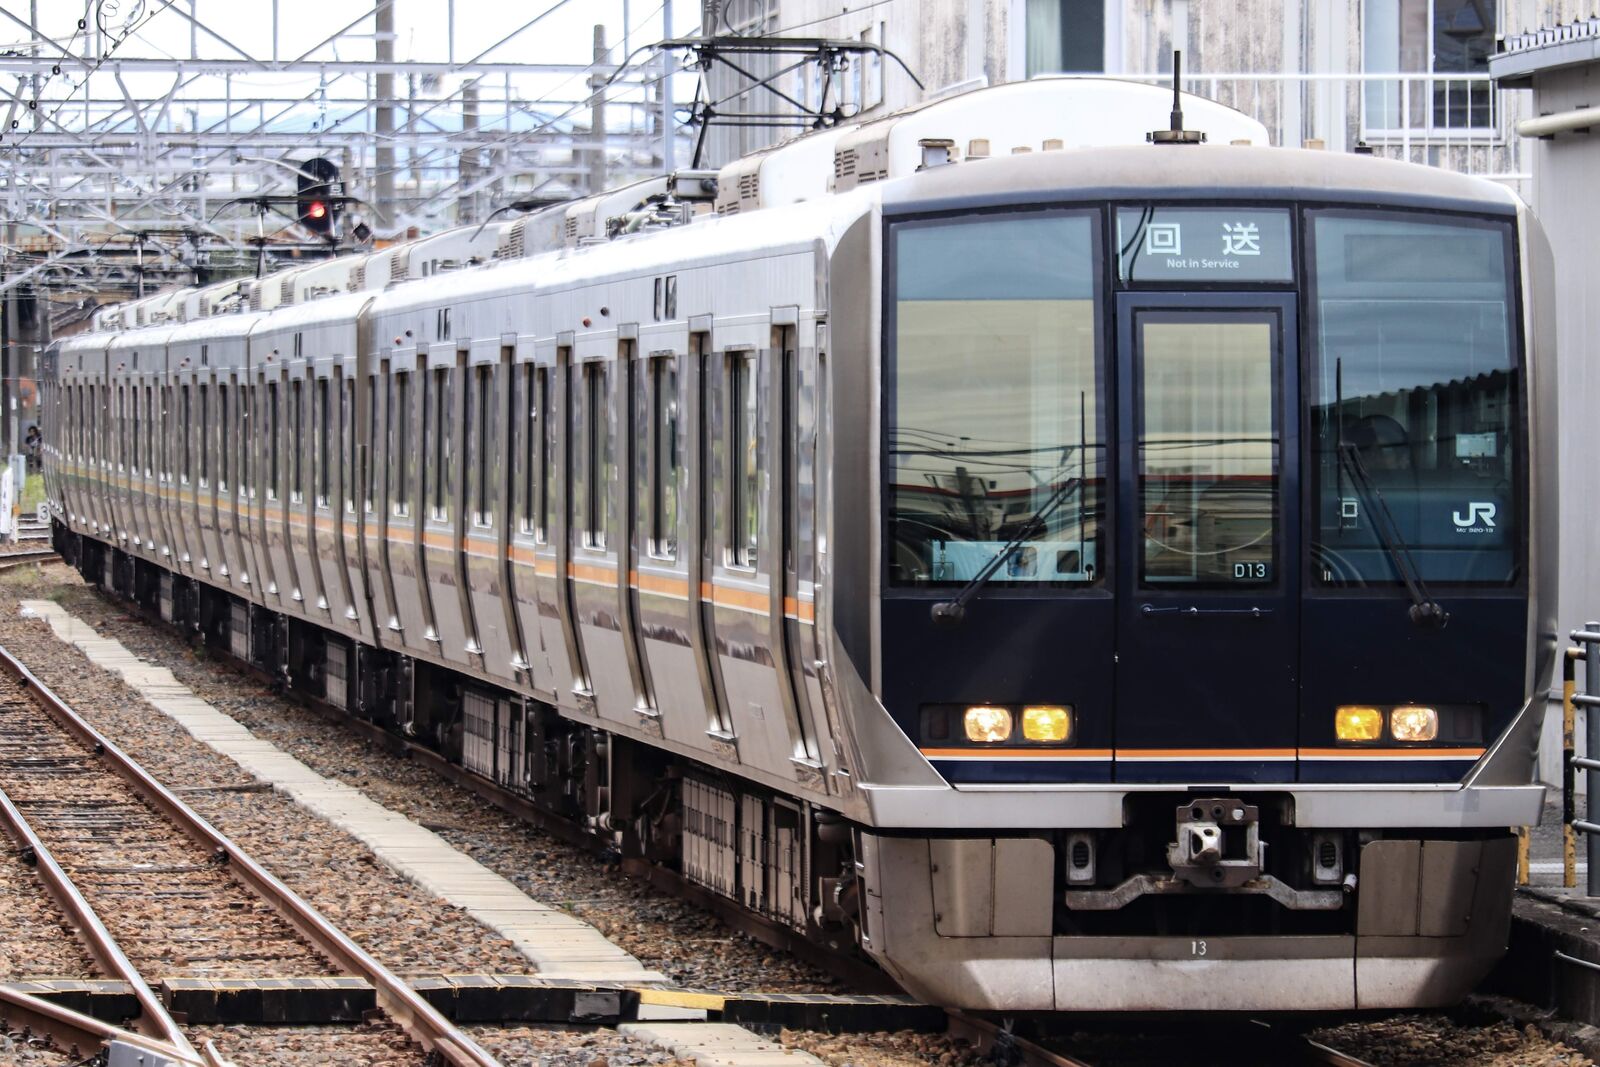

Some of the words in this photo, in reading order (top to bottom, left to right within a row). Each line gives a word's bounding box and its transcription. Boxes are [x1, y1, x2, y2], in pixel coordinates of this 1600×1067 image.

[1167, 259, 1186, 268] Not
[1189, 259, 1199, 268] in
[1202, 259, 1239, 268] Service
[40, 505, 48, 520] 3
[1453, 502, 1496, 527] JR
[1234, 563, 1265, 578] D13
[1191, 941, 1207, 956] 13
